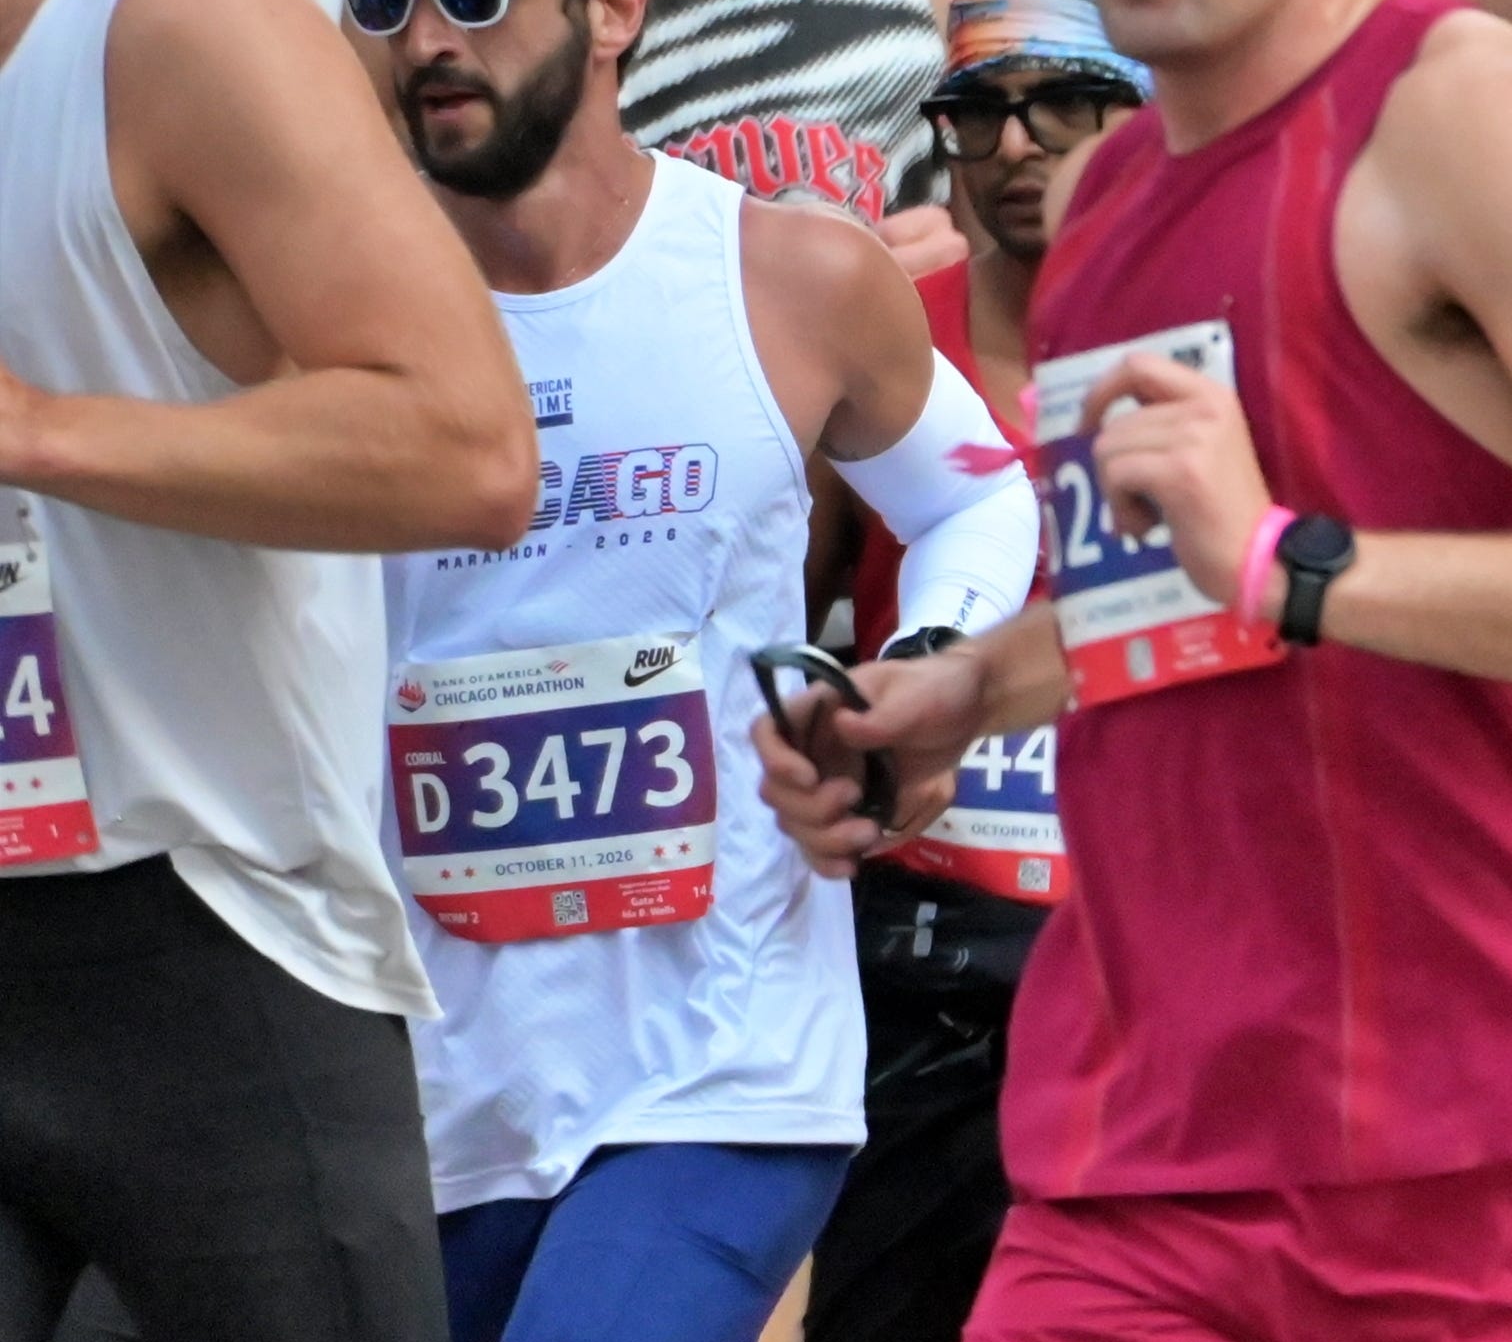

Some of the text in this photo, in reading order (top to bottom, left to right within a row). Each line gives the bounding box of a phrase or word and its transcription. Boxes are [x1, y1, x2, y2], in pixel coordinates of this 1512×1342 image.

[526, 377, 573, 395] ERICAN
[528, 443, 719, 531] CAGO
[437, 543, 548, 571] MARATHON
[595, 527, 677, 549] 2026
[633, 645, 676, 669] RUN
[487, 668, 542, 681] AMERICA
[434, 677, 585, 706] CHICAGO MARATHON
[411, 720, 695, 833] D 3473
[970, 822, 1038, 837] OCTOBER
[495, 857, 566, 877] OCTOBER
[598, 849, 634, 866] 2026
[692, 884, 707, 899] 14
[470, 911, 480, 924] 2
